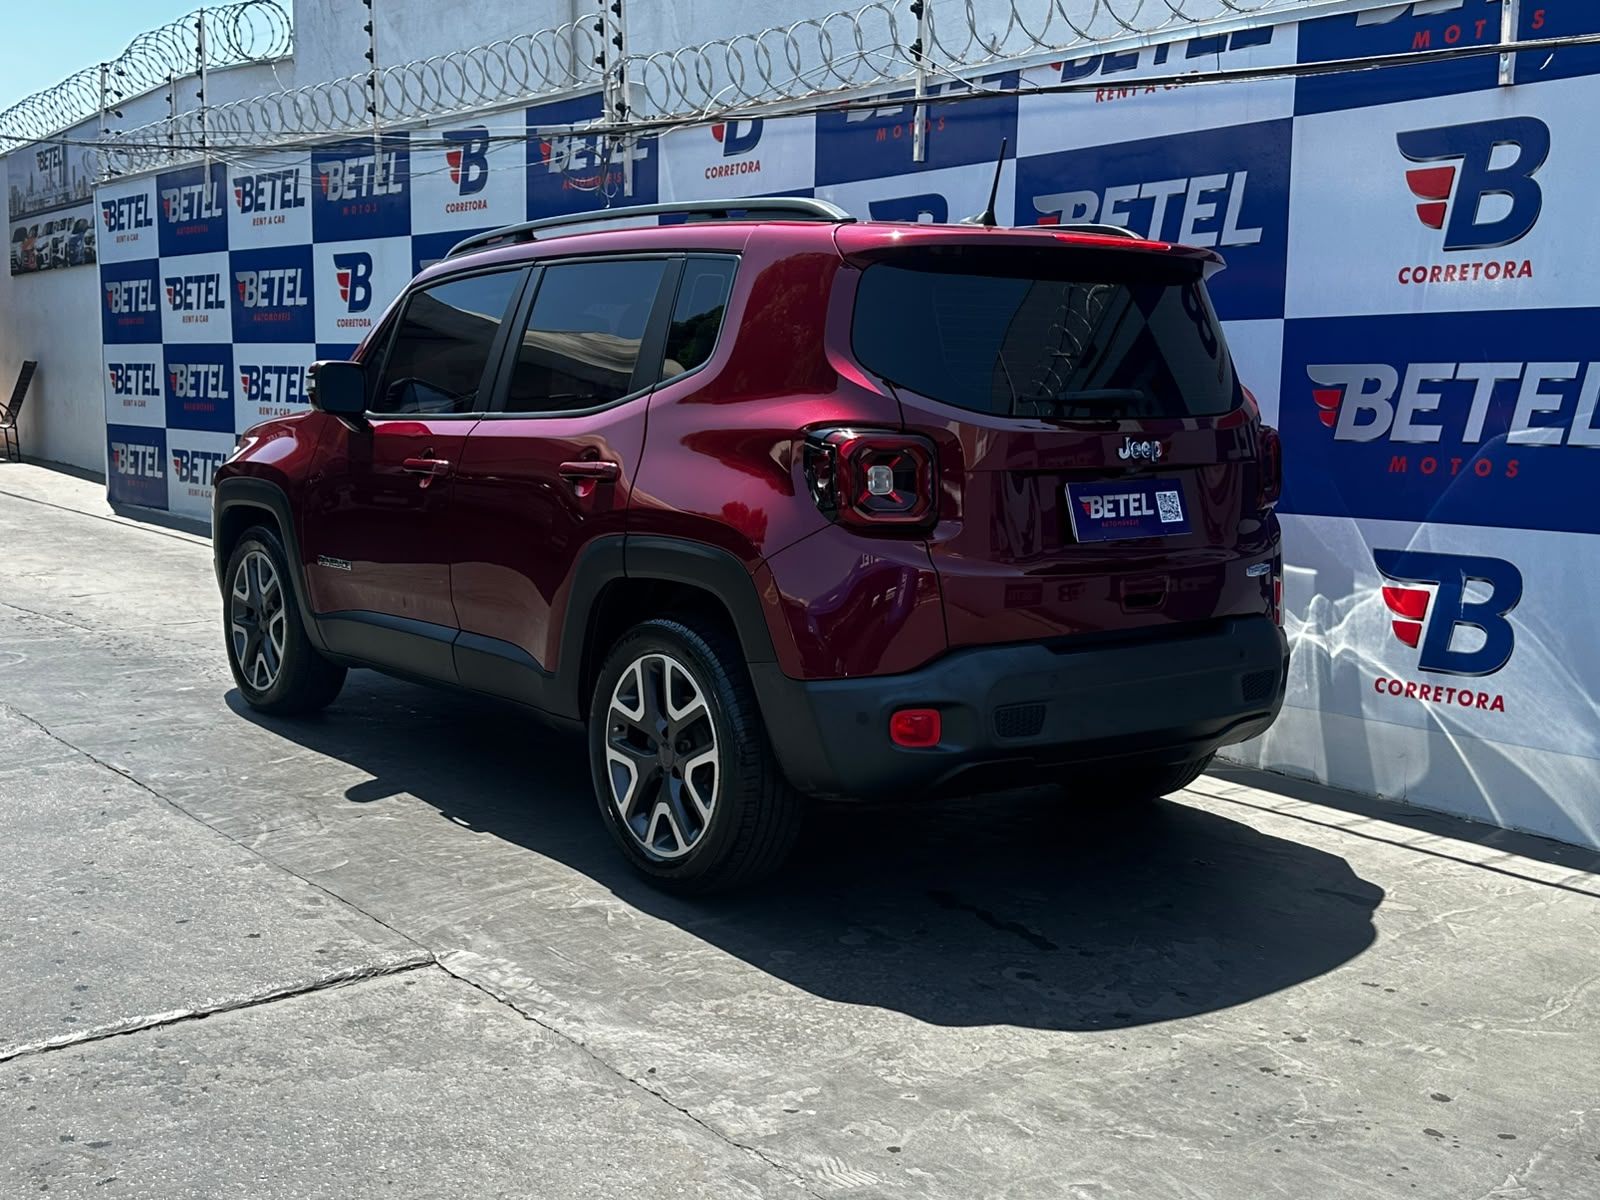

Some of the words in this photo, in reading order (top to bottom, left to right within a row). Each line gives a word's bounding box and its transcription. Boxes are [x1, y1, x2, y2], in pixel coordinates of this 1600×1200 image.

[1412, 10, 1545, 49] MOTS
[318, 152, 402, 201] BETEL
[705, 160, 761, 180] CORRETORA
[161, 182, 223, 223] BETEL
[233, 168, 305, 214] BETEL
[446, 200, 488, 214] CORRETORA
[101, 193, 153, 233] BETEL
[252, 217, 267, 226] RENT
[268, 216, 273, 224] A
[274, 215, 285, 224] CAR
[235, 268, 307, 308] BETEL
[1398, 260, 1533, 284] CORRETORA
[105, 279, 156, 314] BETEL
[165, 273, 225, 311] BETEL
[337, 318, 372, 328] CORRETORA
[108, 363, 160, 396] BETEL
[168, 363, 229, 399] BETEL
[239, 365, 310, 404] BETEL
[259, 407, 273, 415] RENT
[1306, 361, 1600, 448] BETEL
[111, 442, 163, 478] BETEL
[172, 449, 226, 486] BETE
[1118, 437, 1162, 463] Jeep
[1388, 456, 1519, 478] MOTOS
[1078, 493, 1154, 520] BETEL
[1374, 677, 1505, 712] CORRETORA
